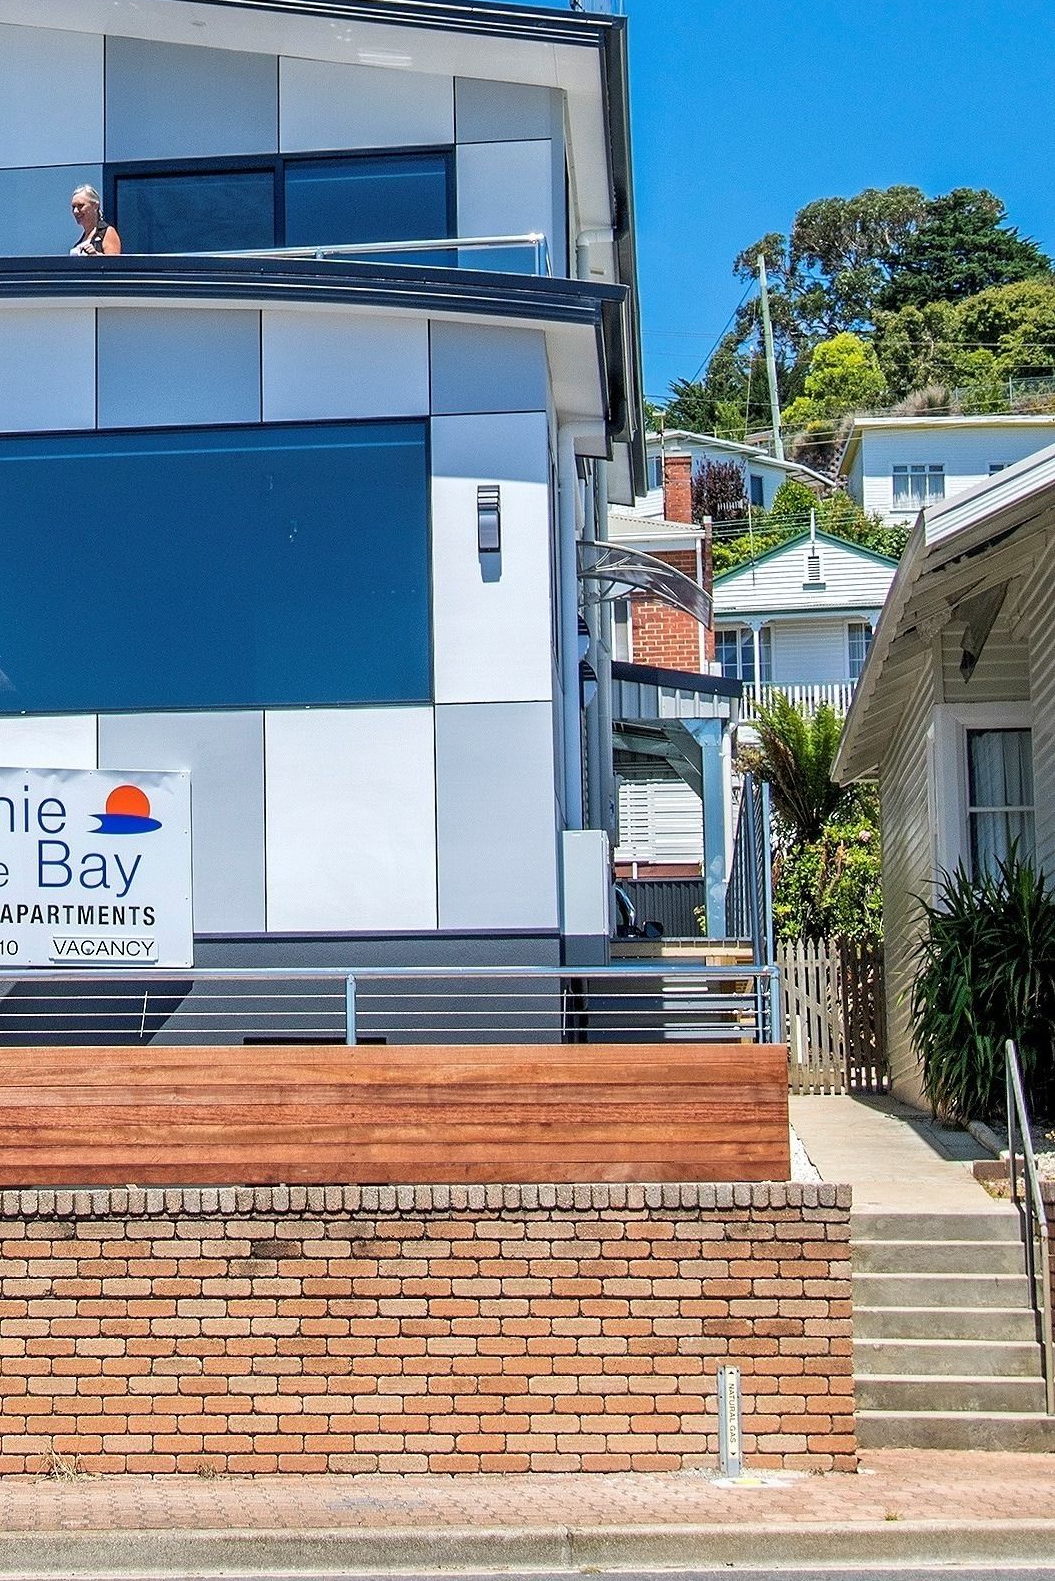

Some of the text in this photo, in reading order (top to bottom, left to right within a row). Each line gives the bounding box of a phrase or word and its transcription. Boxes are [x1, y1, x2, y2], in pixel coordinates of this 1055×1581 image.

[37, 839, 143, 898] Bay
[0, 903, 156, 927] APARTMENTS
[52, 939, 155, 957] VACANCY
[728, 1382, 737, 1444] NATURAL GAS
